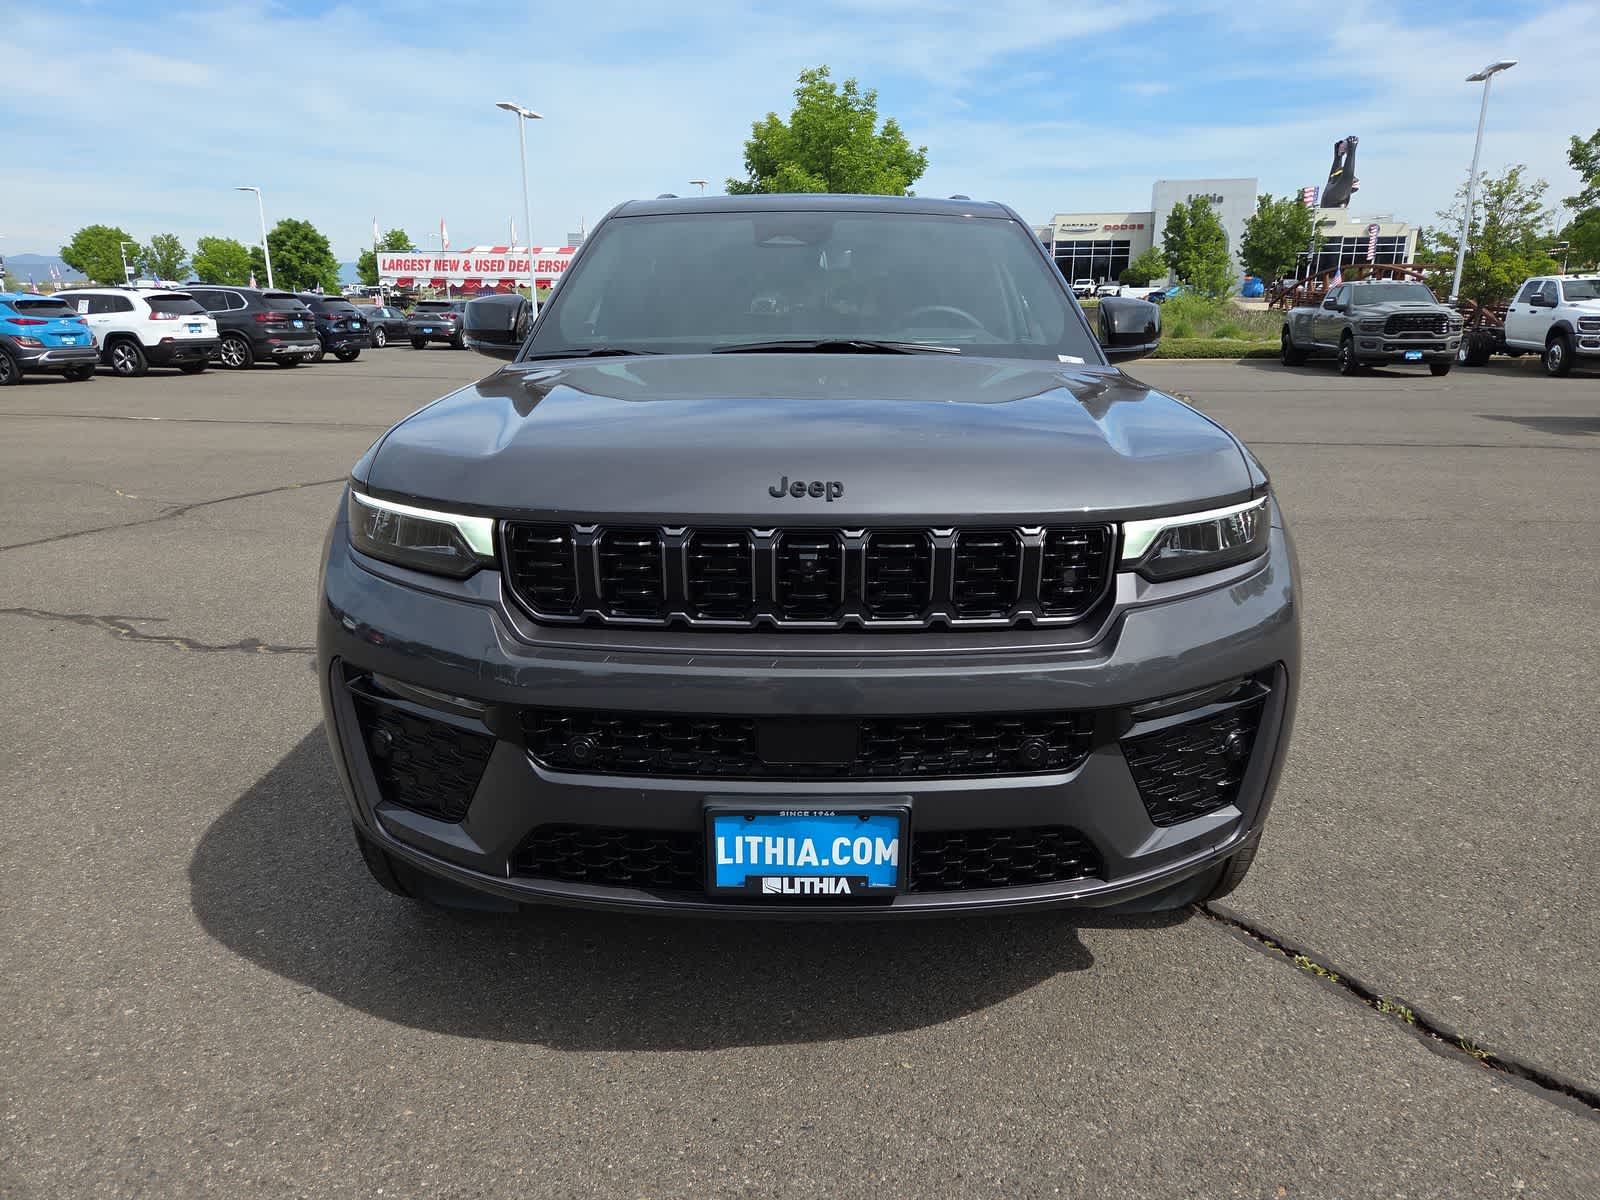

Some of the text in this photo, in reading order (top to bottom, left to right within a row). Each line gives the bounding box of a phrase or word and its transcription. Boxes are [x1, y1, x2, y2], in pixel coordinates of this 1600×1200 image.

[382, 259, 569, 273] LARGEST NEW & USED DEAERSH
[768, 476, 844, 502] Jeep
[716, 835, 899, 867] LITHIA.COM
[782, 877, 852, 895] LITHIA
